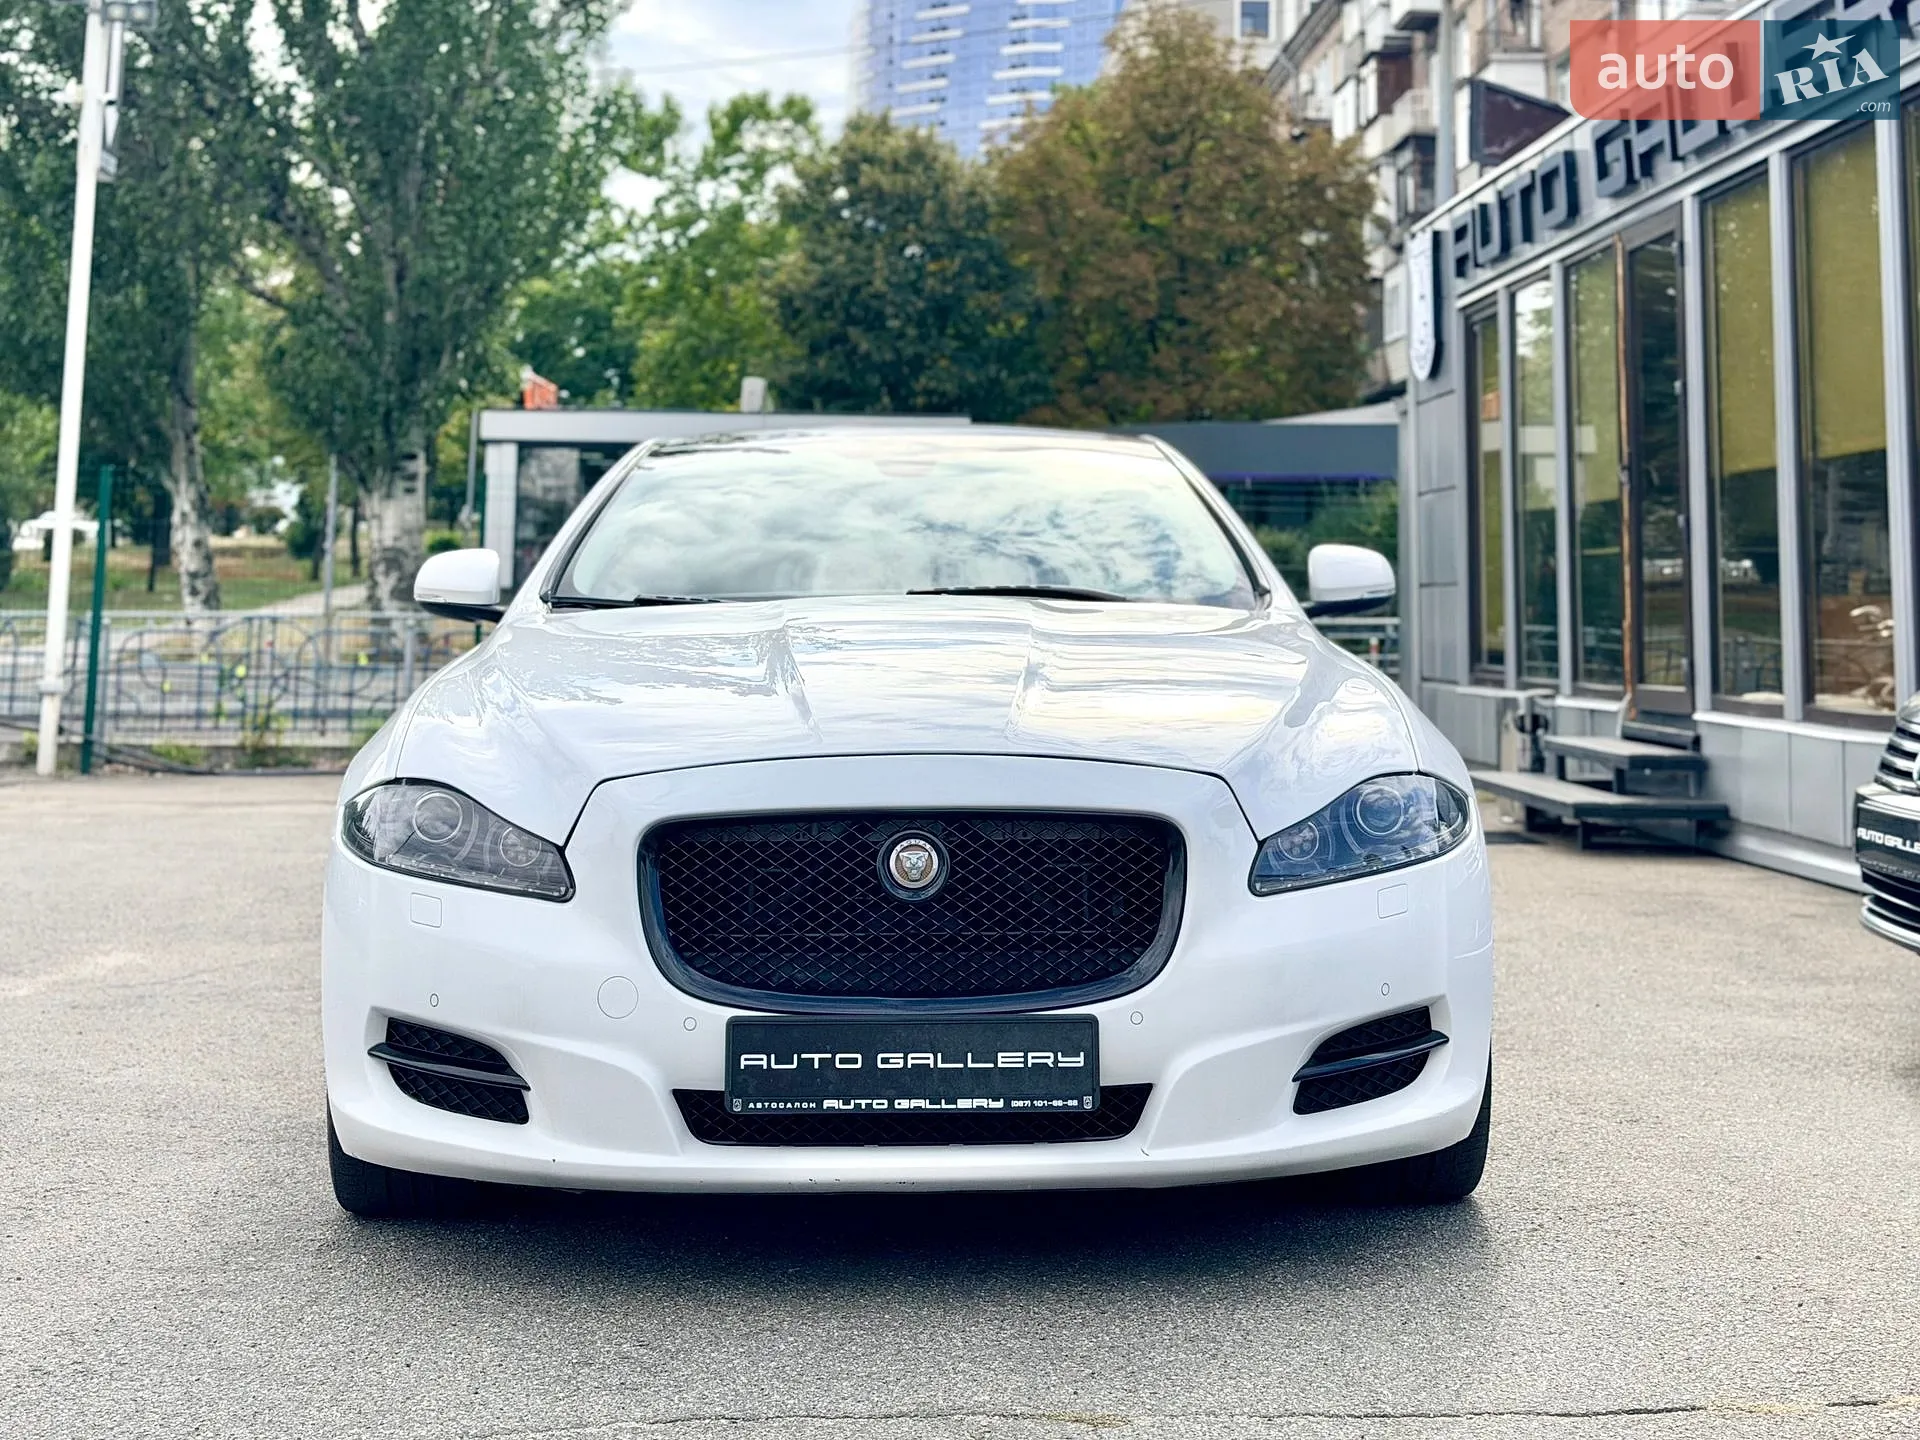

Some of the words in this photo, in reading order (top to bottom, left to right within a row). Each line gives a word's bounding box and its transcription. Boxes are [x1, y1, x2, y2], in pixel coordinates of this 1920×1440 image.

[1450, 148, 1577, 280] AUTO
[1856, 827, 1884, 844] AUTO
[740, 1052, 863, 1070] AUTO
[876, 1051, 1085, 1069] GALLERY
[748, 1101, 816, 1109] АВТОСАЛОН
[823, 1099, 889, 1110] AUTO
[894, 1098, 1004, 1109] GALLERY
